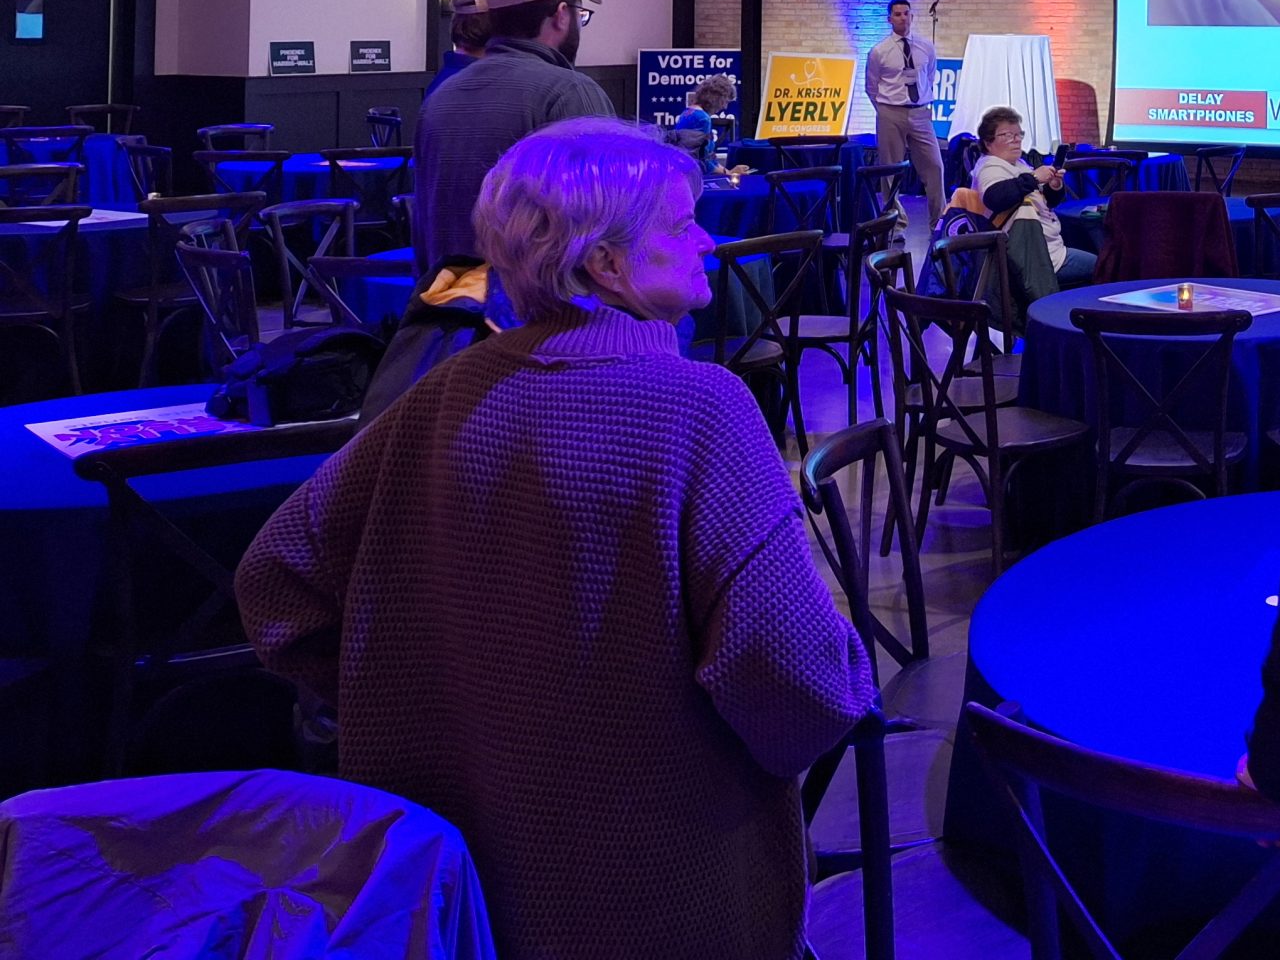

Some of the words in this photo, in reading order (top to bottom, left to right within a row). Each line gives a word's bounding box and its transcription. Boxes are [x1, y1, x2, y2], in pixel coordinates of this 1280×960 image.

[658, 55, 704, 68] VOTE
[709, 55, 733, 68] for
[648, 72, 741, 85] Democs.
[774, 88, 793, 98] DR.
[1179, 93, 1224, 105] DELAY
[765, 101, 845, 121] LYERLY
[1148, 108, 1254, 123] SMARTPHONES
[789, 124, 831, 132] CONGRESS
